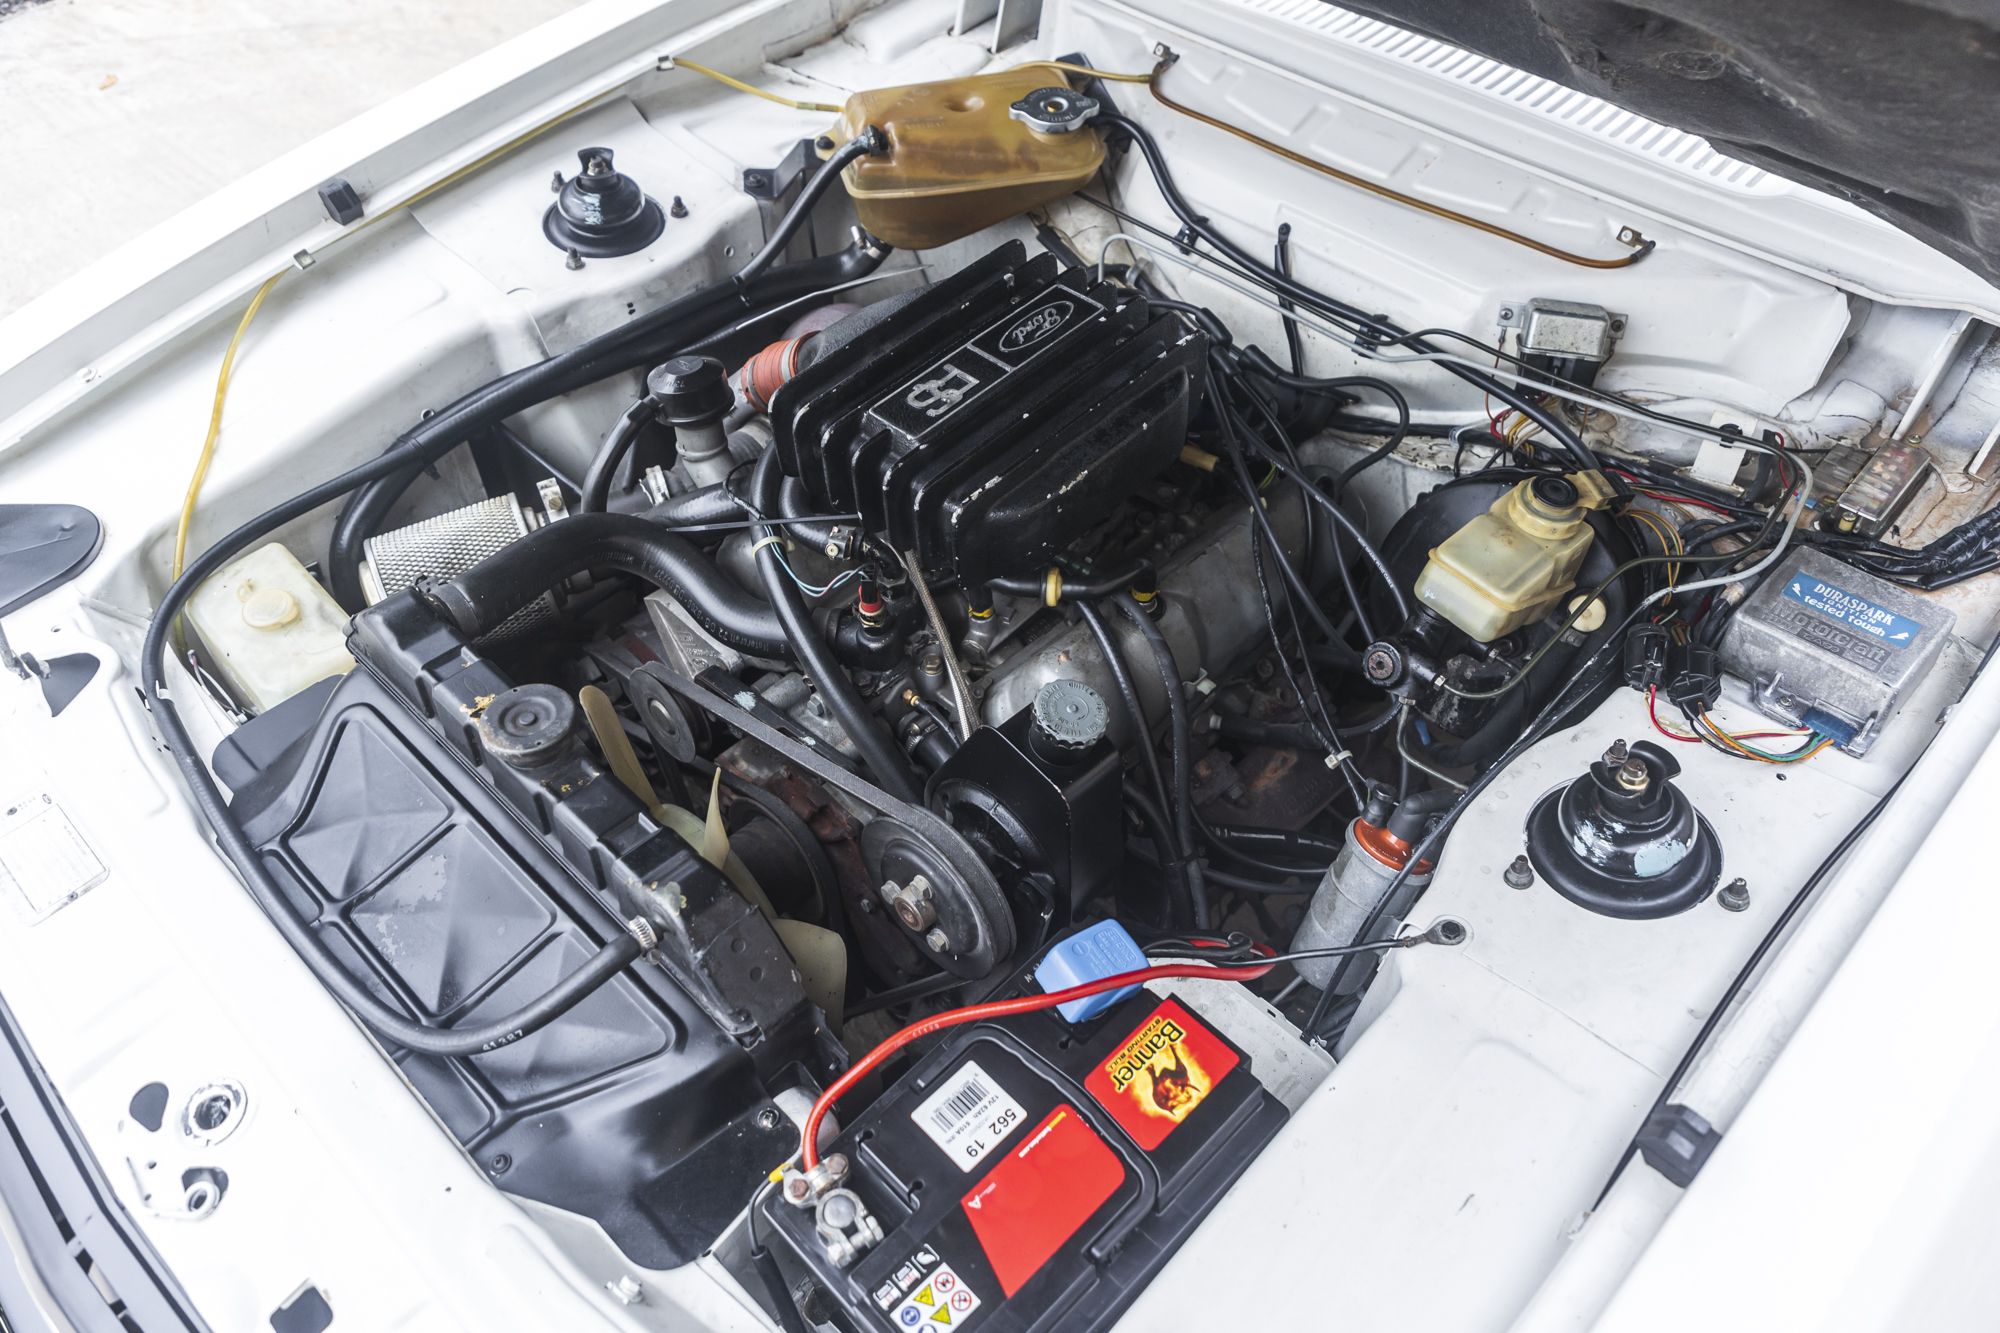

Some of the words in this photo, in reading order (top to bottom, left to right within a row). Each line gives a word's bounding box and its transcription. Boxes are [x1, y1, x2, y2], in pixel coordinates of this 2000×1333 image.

[1009, 305, 1060, 344] Ford
[1804, 595, 1845, 618] tested
[1848, 615, 1886, 637] tough
[1813, 583, 1896, 625] DURASPARK
[1822, 598, 1877, 624] IGNITION
[1771, 602, 1887, 662] Motorcraft
[1125, 1017, 1162, 1053] STARTING
[1107, 1052, 1127, 1071] BULL
[1111, 1020, 1184, 1093] Banner
[987, 1107, 1018, 1136] 562
[964, 1139, 988, 1159] 19
